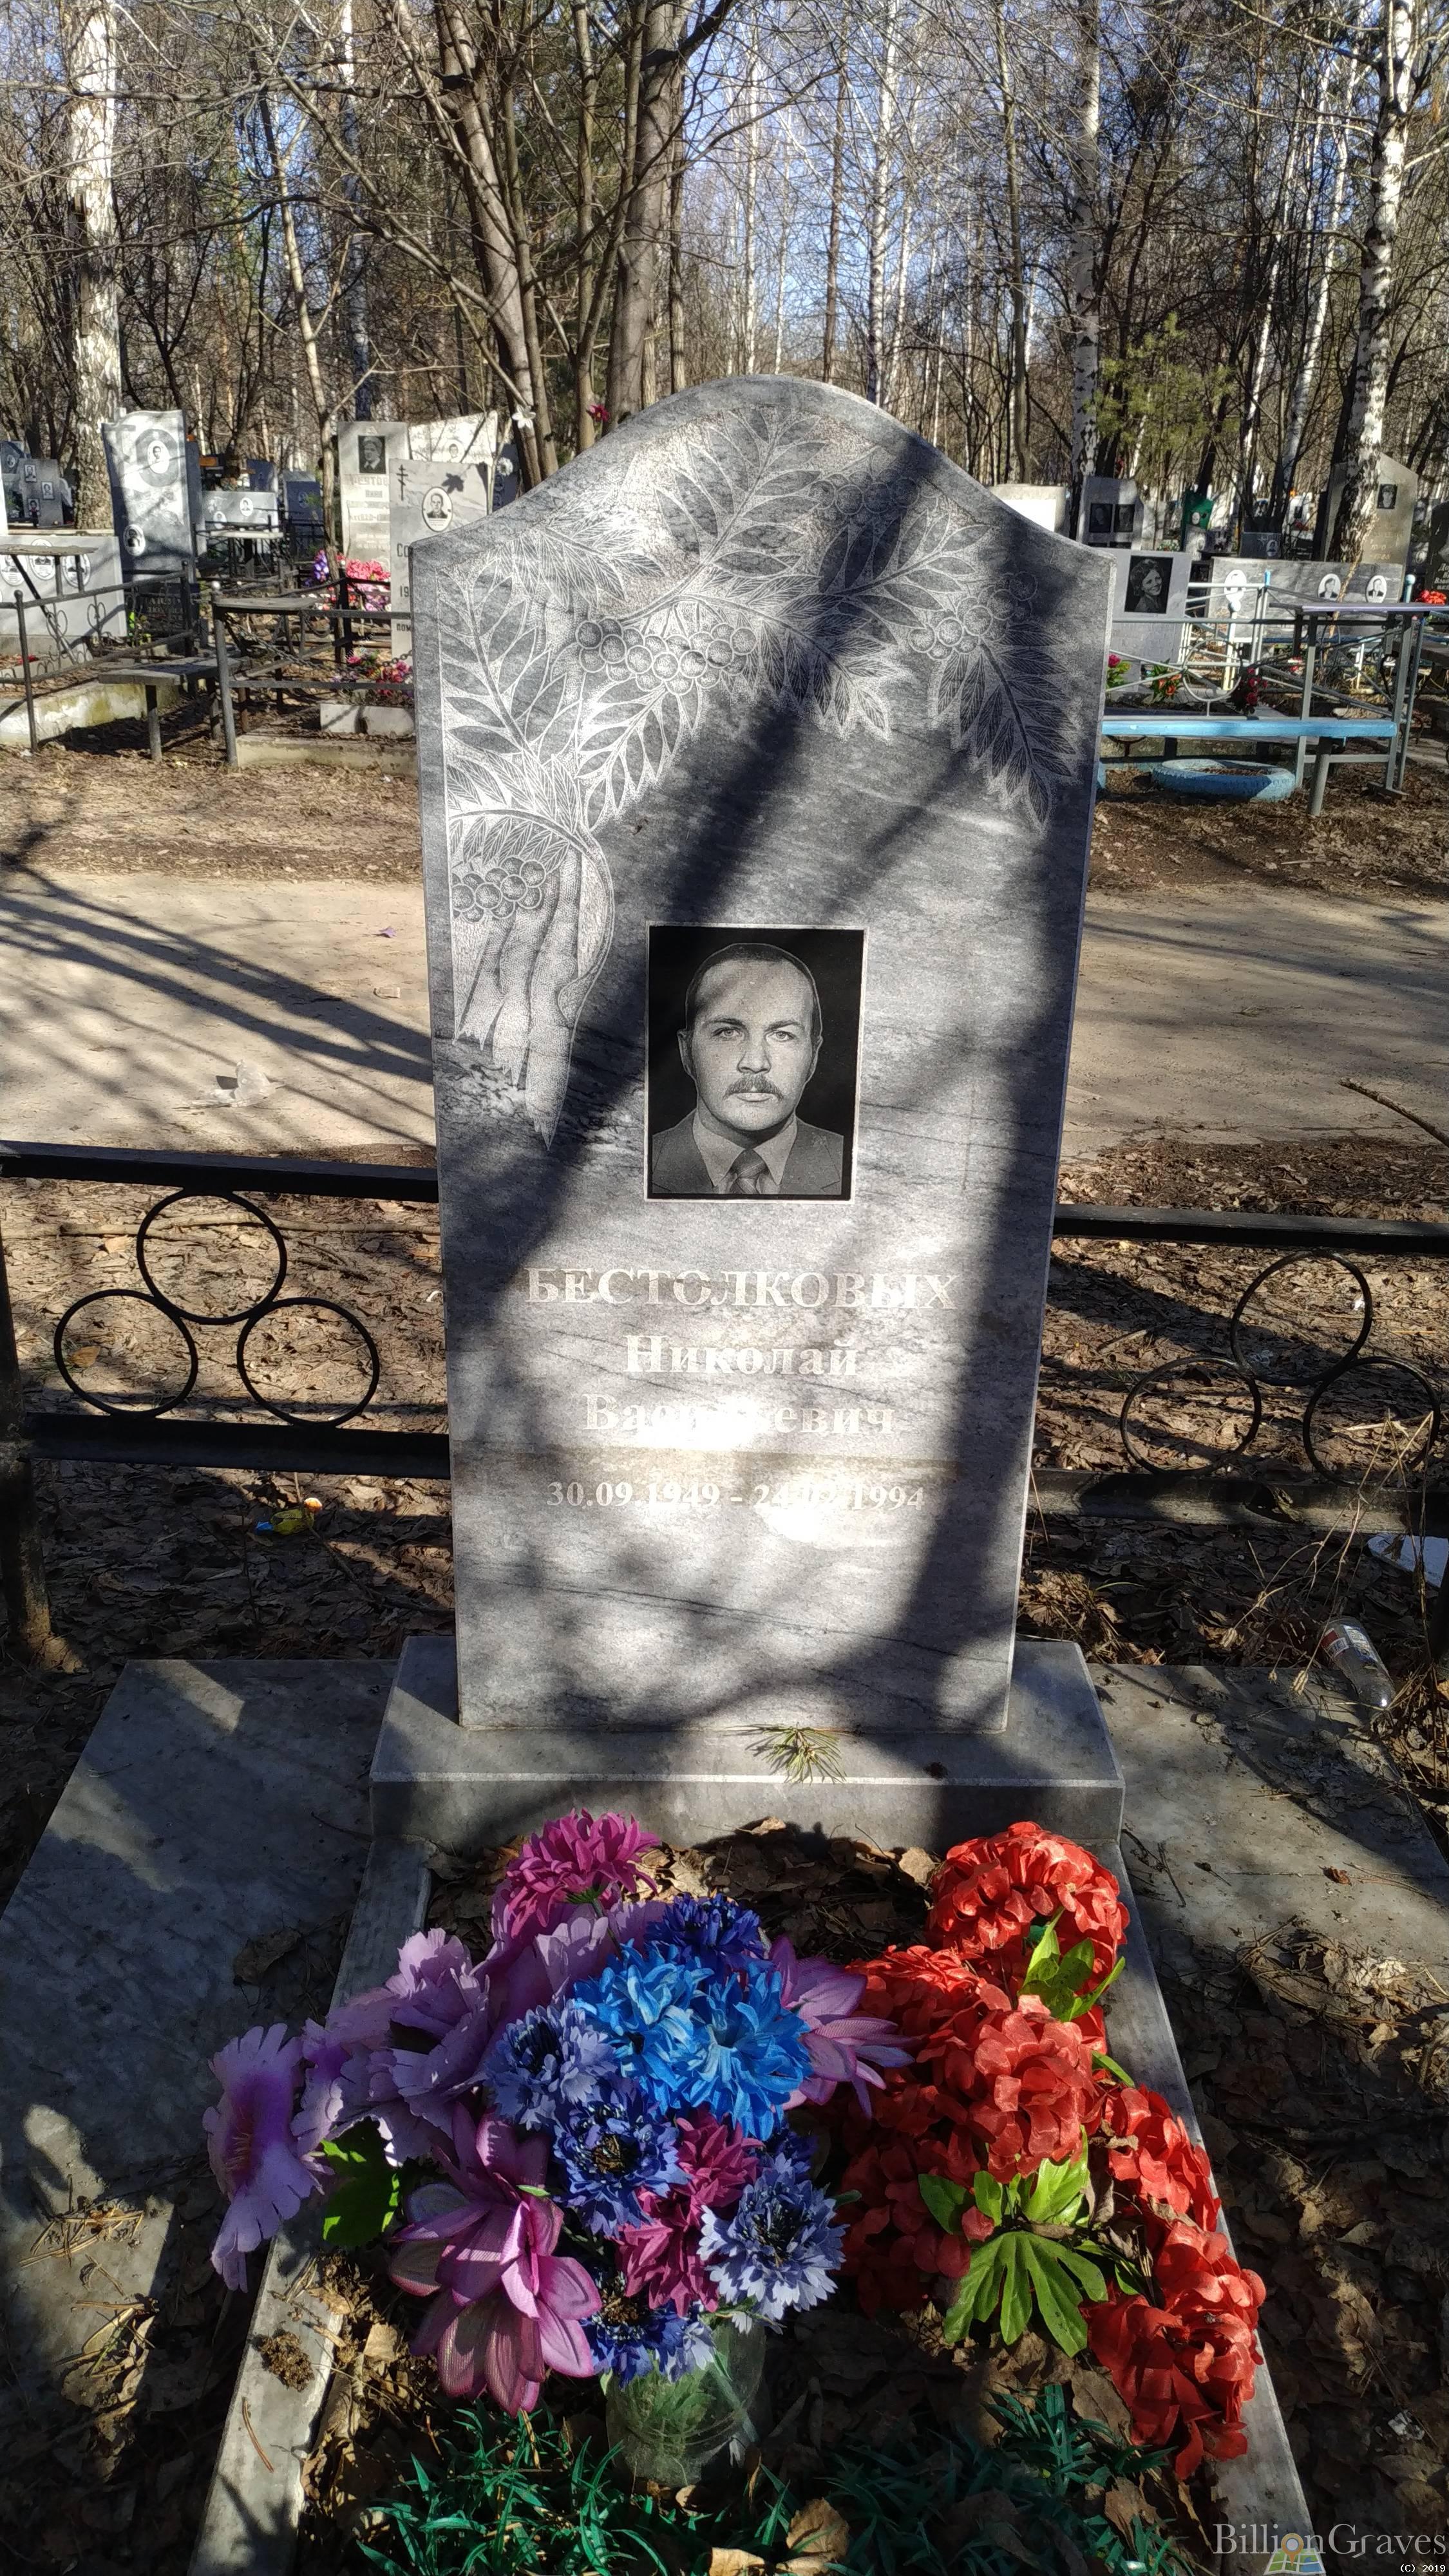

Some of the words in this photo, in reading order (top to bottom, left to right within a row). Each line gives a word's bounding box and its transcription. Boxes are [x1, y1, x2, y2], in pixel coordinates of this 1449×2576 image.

[524, 1267, 959, 1309] БЕСТОЛКОВЫХ
[623, 1334, 858, 1376] Николай
[582, 1393, 895, 1435] Васевич
[547, 1482, 721, 1508] 30.09.1949
